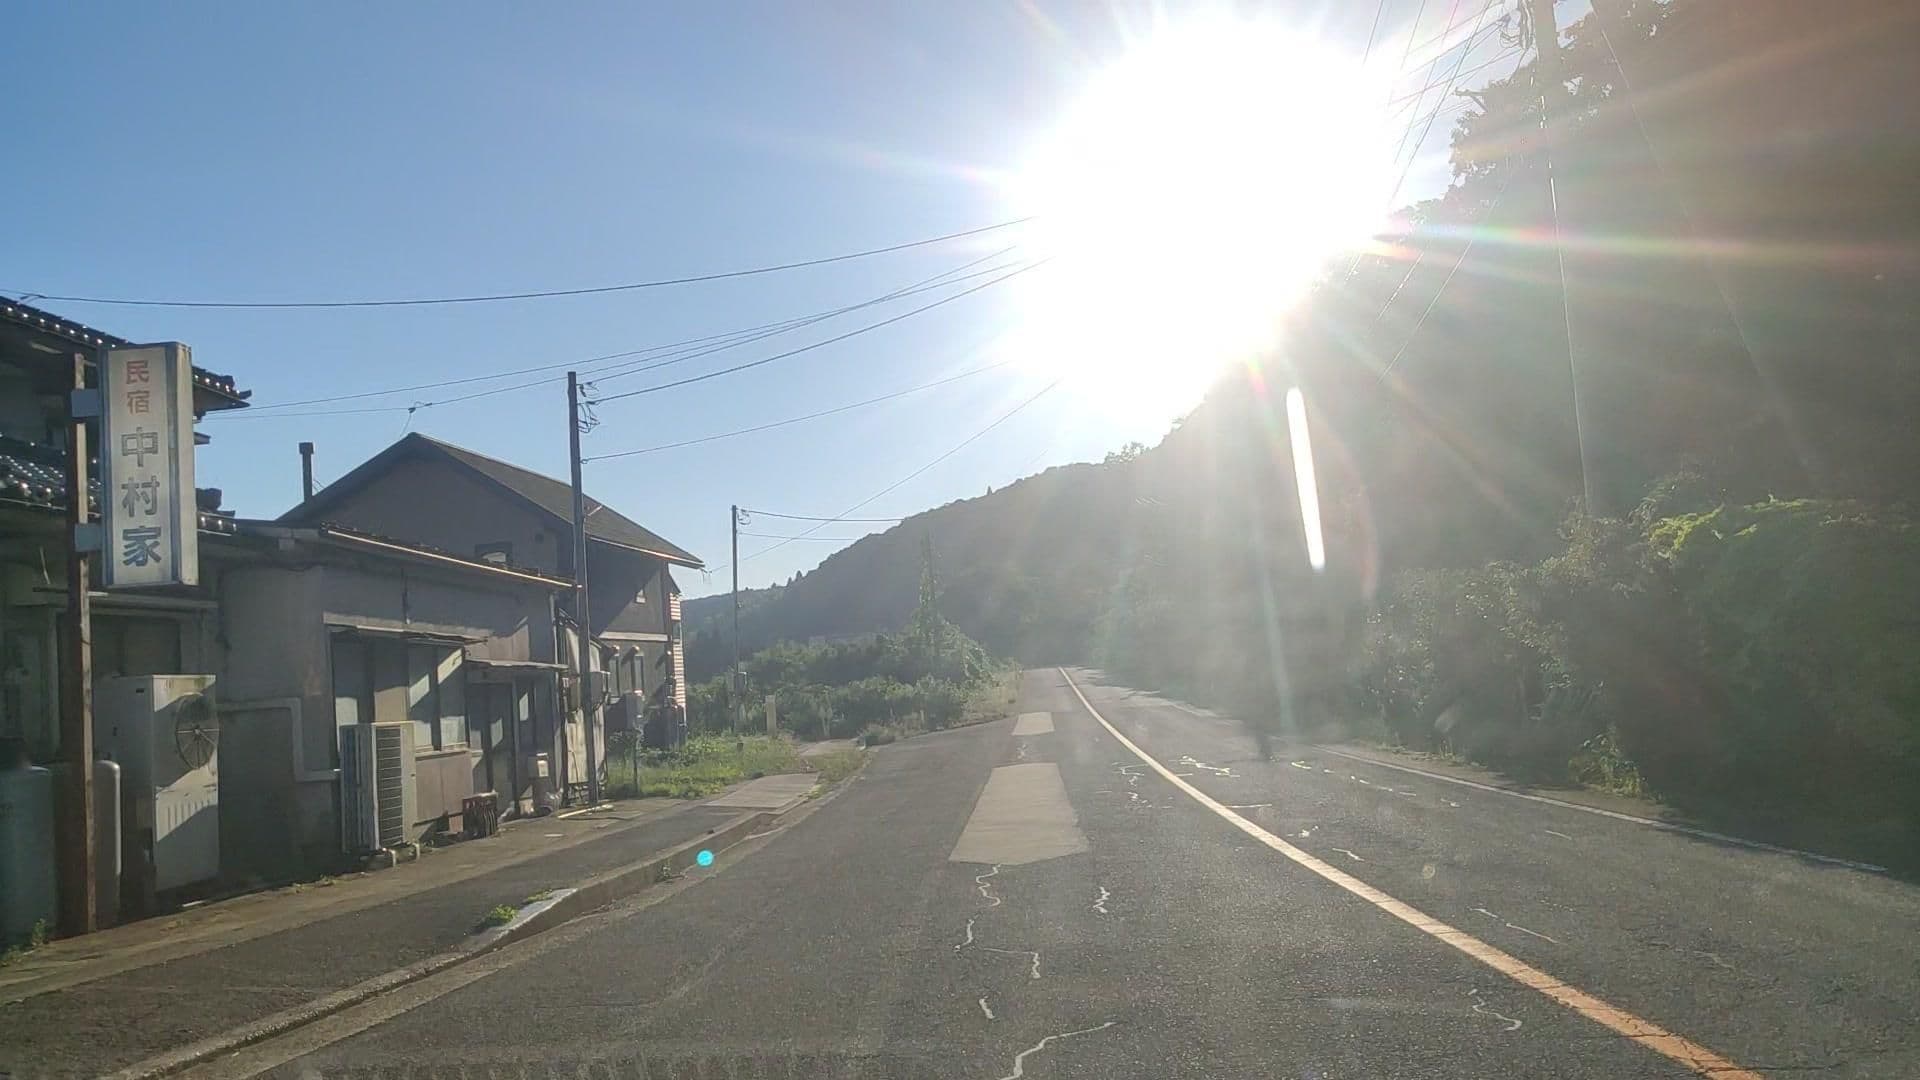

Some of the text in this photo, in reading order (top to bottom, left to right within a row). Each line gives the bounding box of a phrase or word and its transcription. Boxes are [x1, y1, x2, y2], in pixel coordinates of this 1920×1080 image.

[126, 360, 150, 414] 民宿
[121, 426, 162, 567] 中村家
